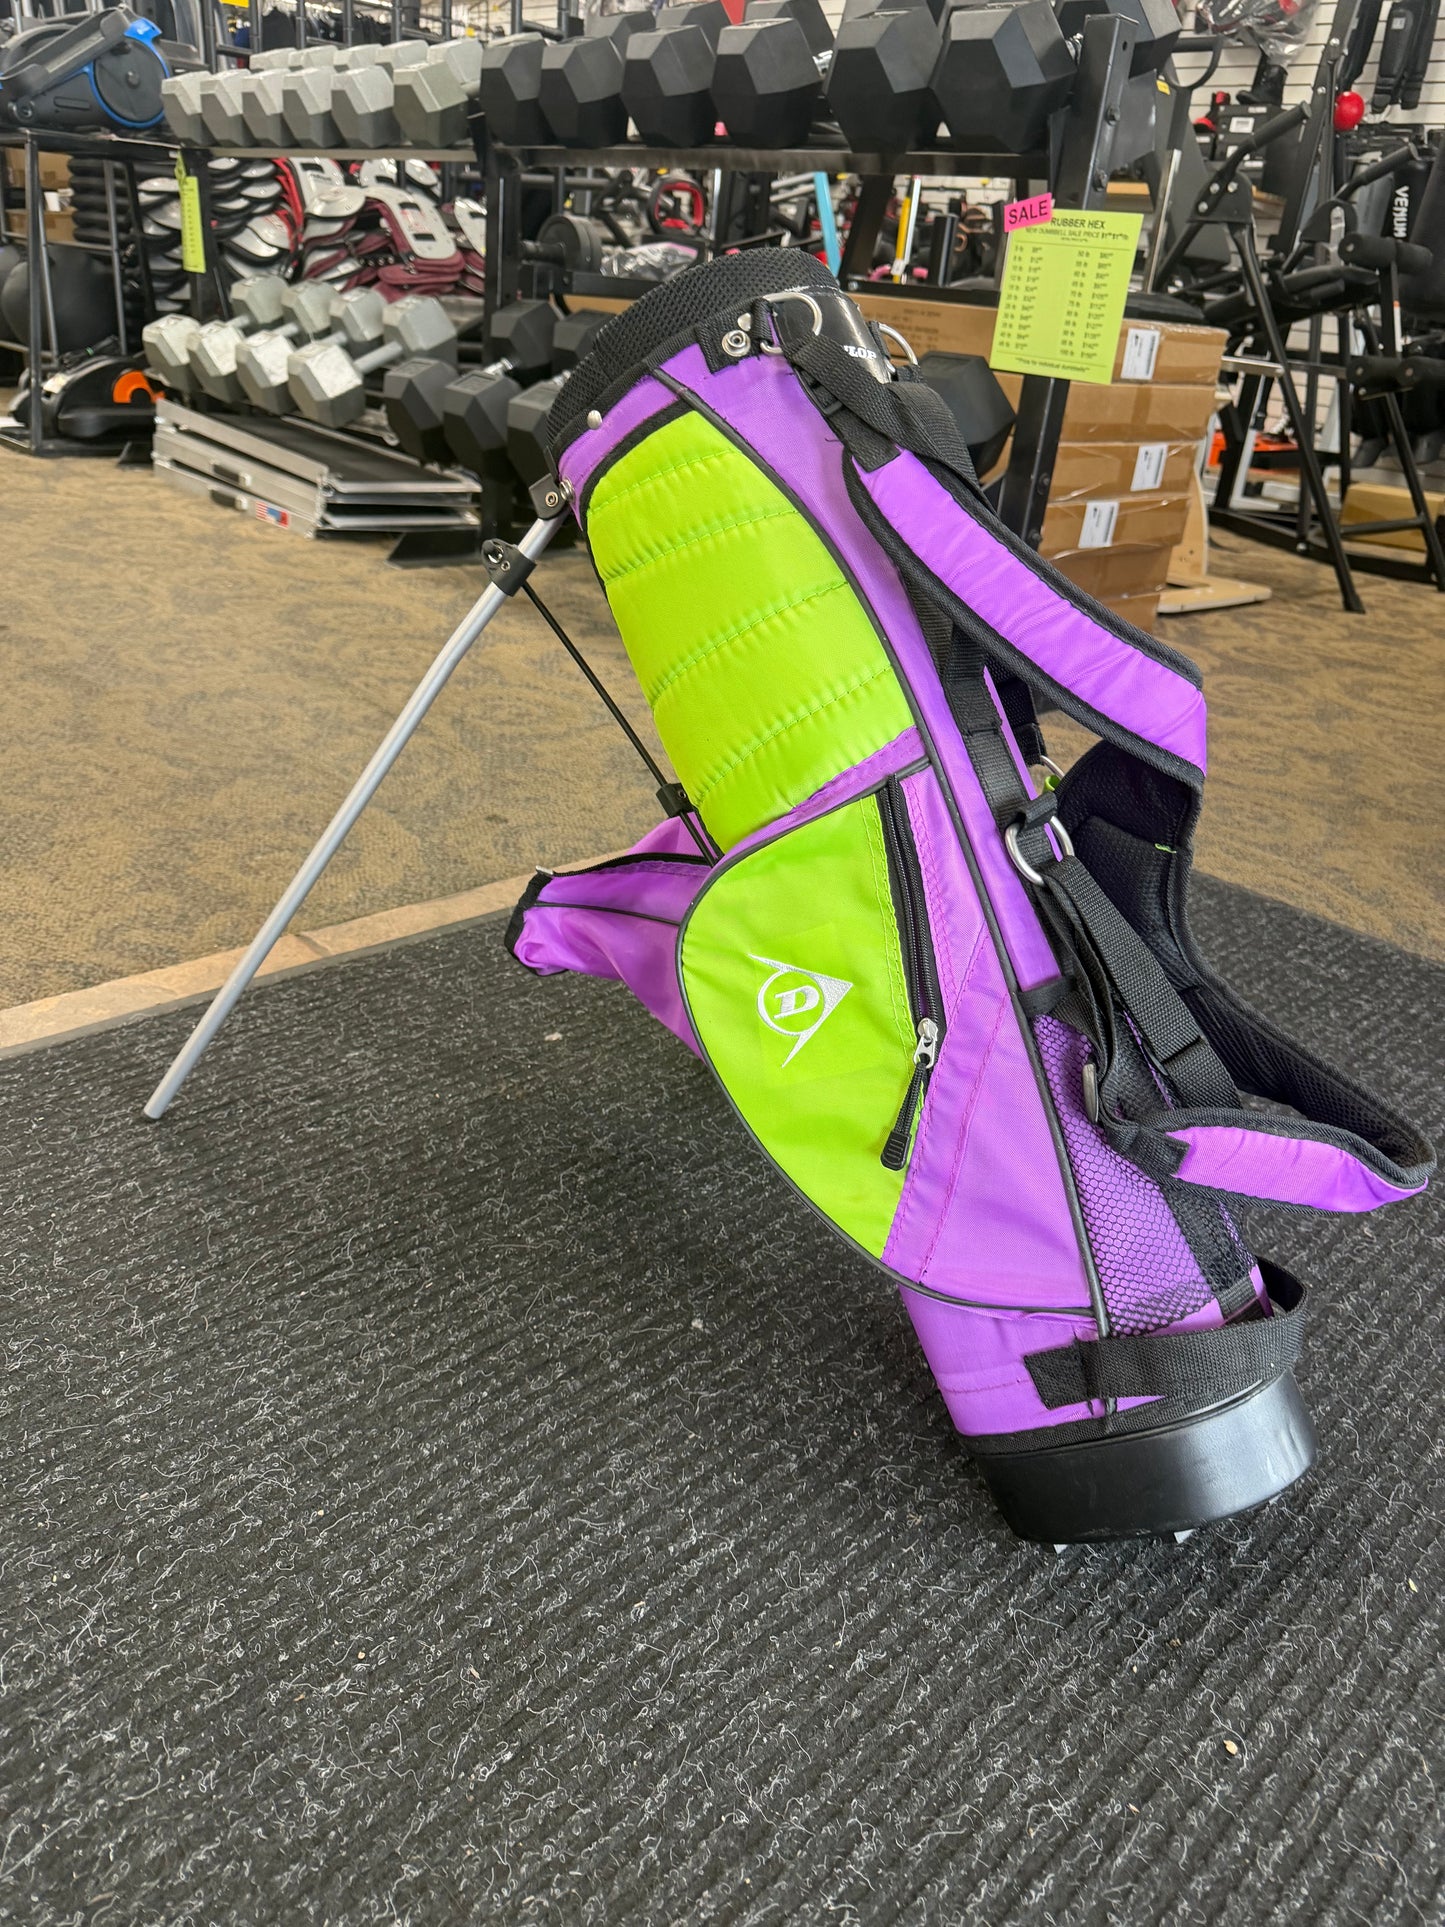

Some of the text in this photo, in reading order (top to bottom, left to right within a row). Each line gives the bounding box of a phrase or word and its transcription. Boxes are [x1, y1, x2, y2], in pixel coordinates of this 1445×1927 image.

[1008, 199, 1048, 225] SALE
[1050, 216, 1106, 230] RUBBER HEX
[1392, 185, 1410, 238] VENUM
[773, 985, 820, 1019] D
